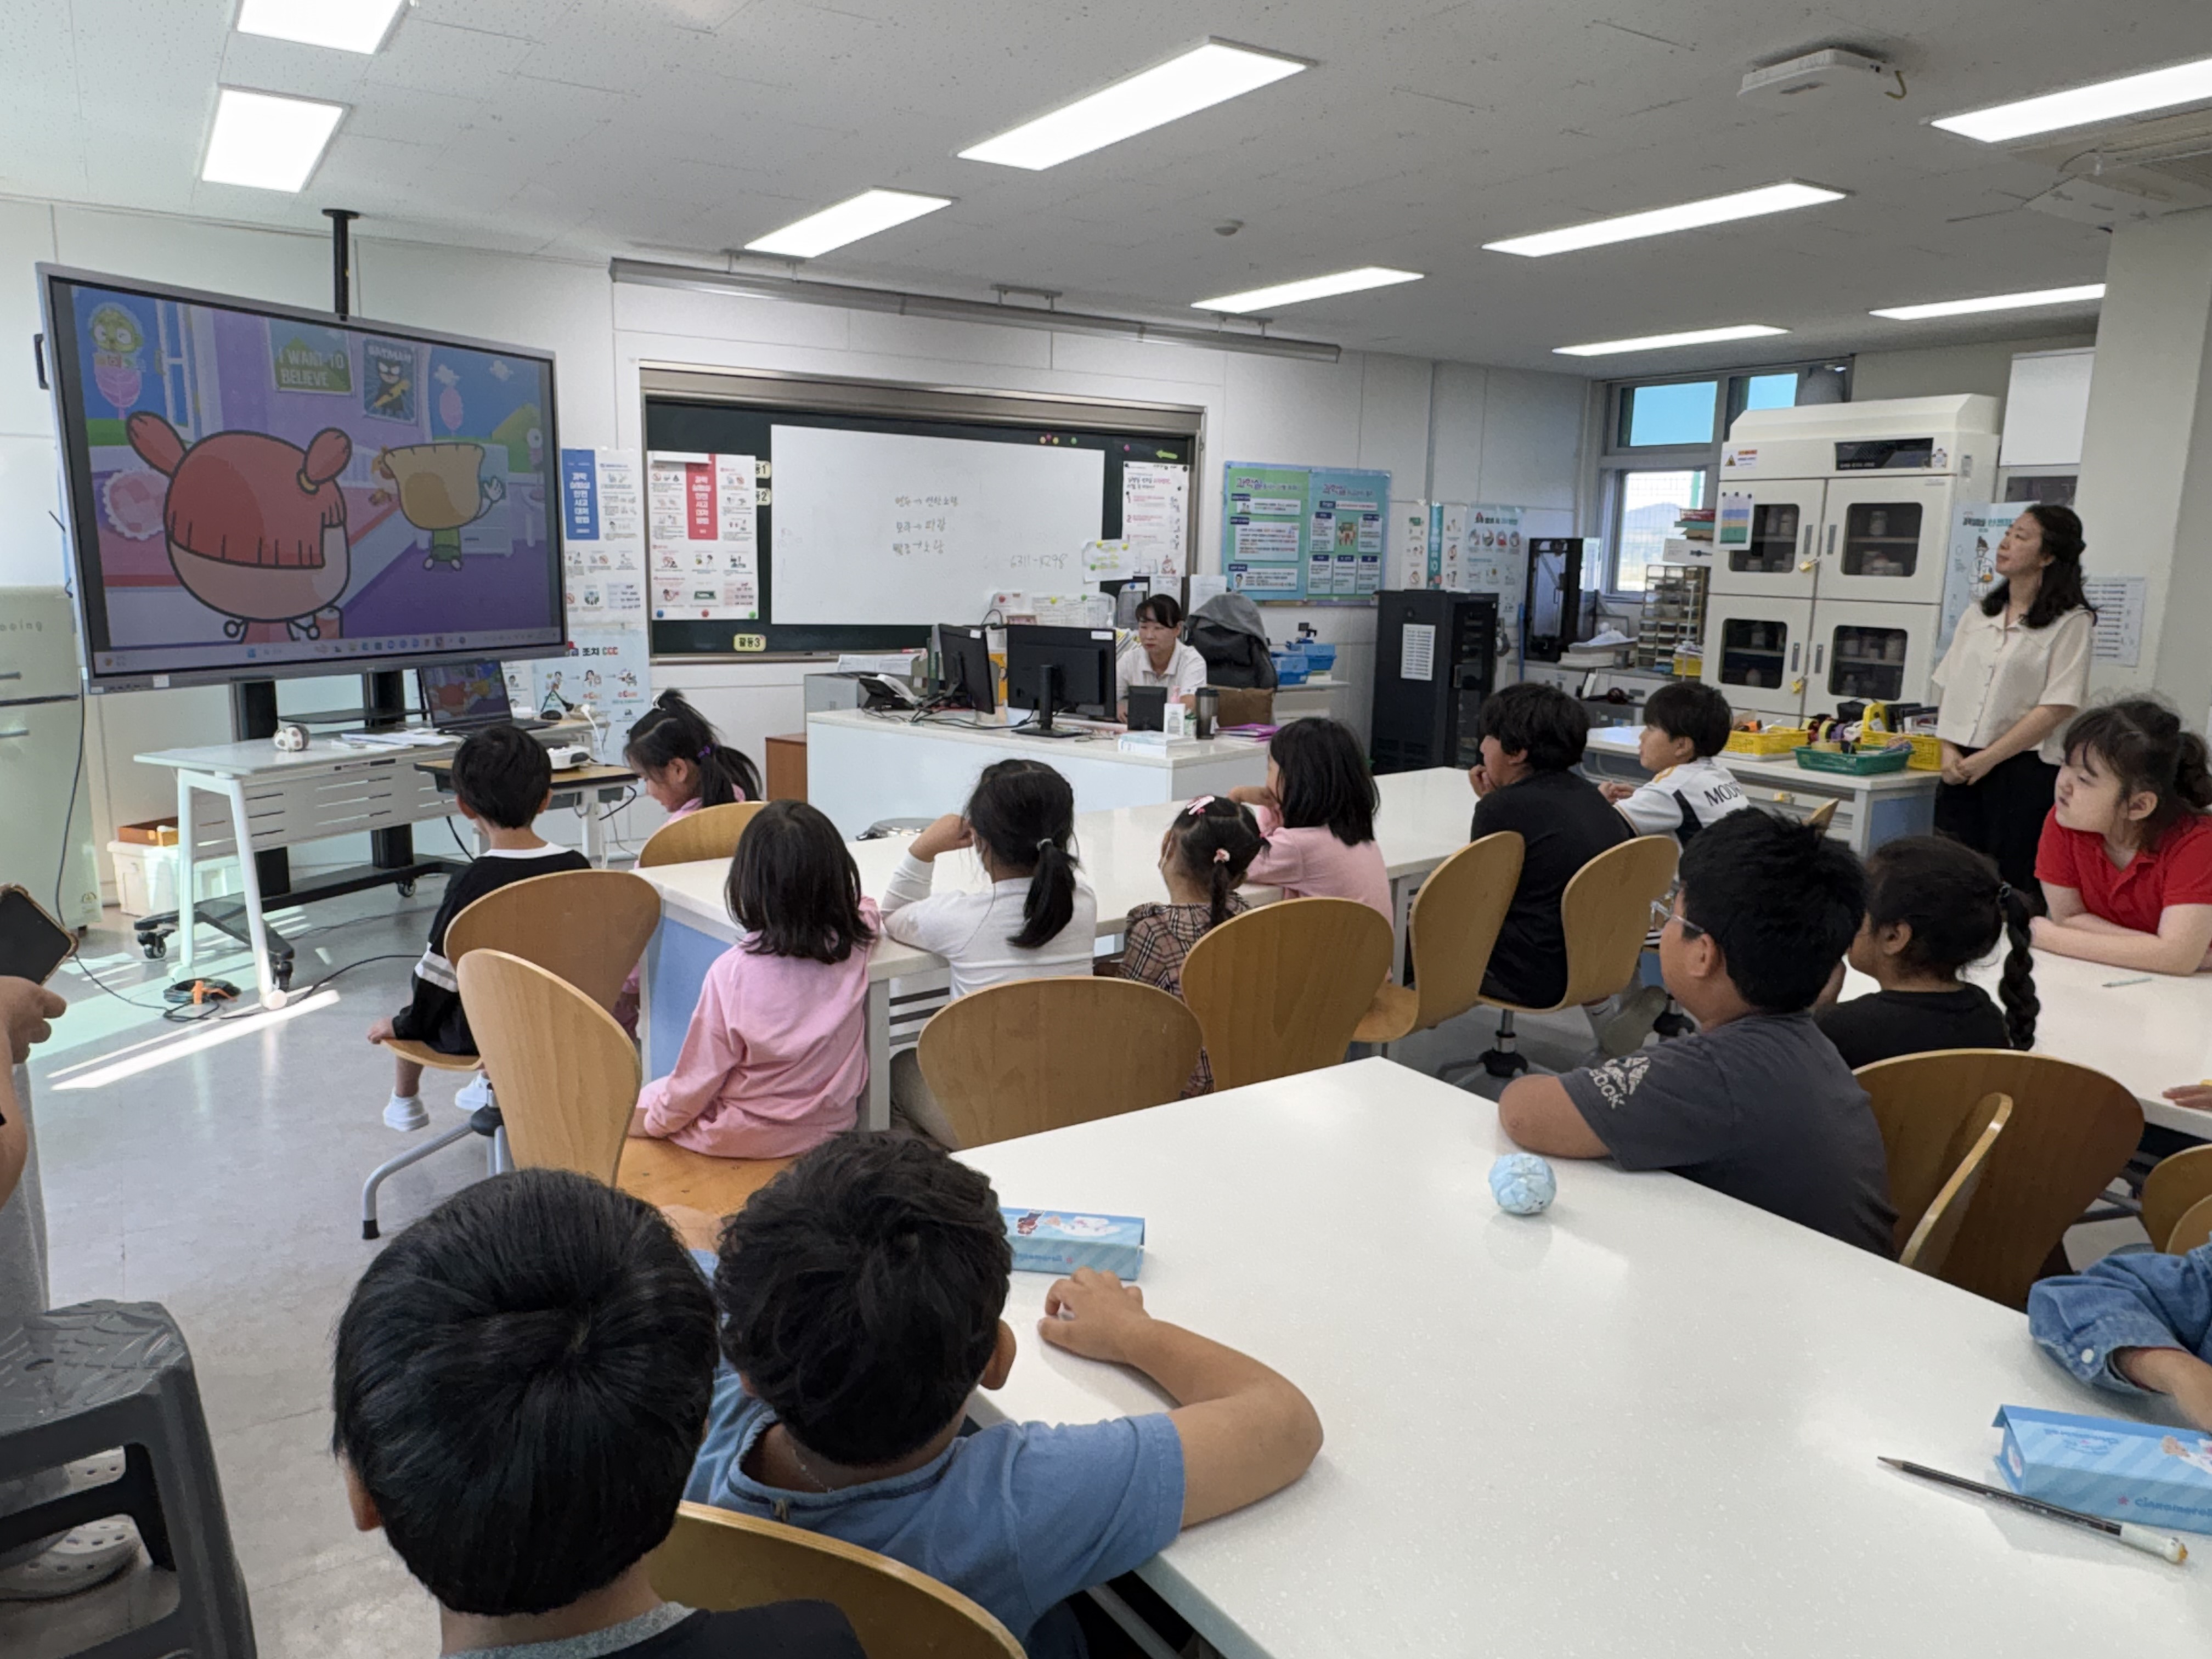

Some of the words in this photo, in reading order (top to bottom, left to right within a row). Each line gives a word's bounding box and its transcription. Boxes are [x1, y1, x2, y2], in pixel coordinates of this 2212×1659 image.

[287, 349, 323, 366] WANT
[328, 354, 345, 369] TO
[280, 368, 329, 387] BELIEVE
